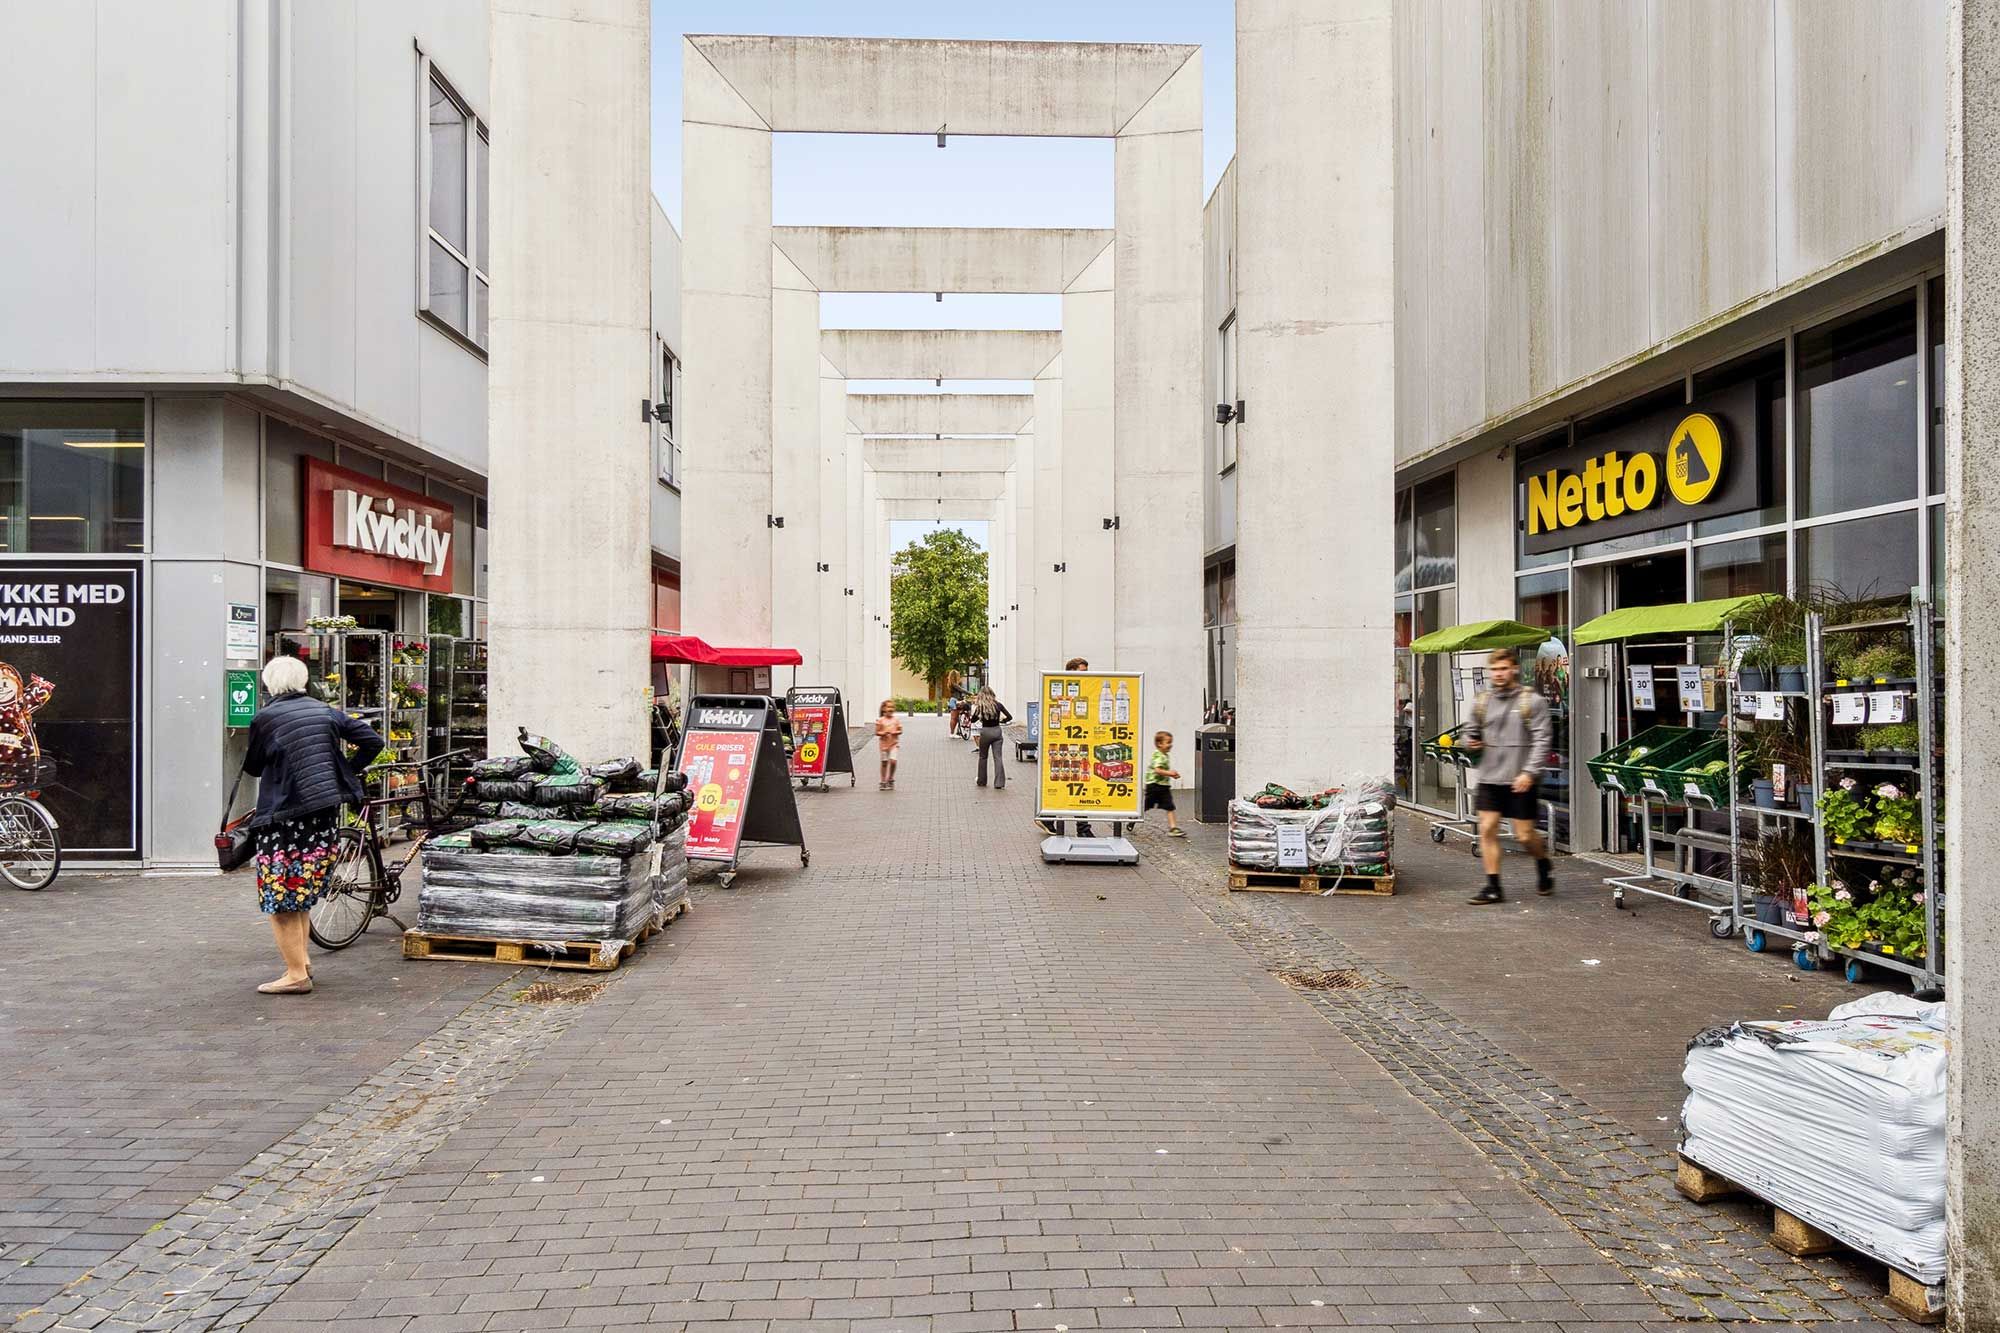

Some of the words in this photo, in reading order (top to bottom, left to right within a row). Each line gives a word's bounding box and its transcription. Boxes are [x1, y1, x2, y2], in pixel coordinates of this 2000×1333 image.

[1528, 451, 1657, 536] Netto
[335, 489, 451, 577] Kvickly
[0, 584, 60, 604] KKE
[66, 584, 126, 604] MED
[28, 635, 61, 643] ELLER
[699, 709, 754, 728] Kvickly
[716, 744, 745, 752] PRISER
